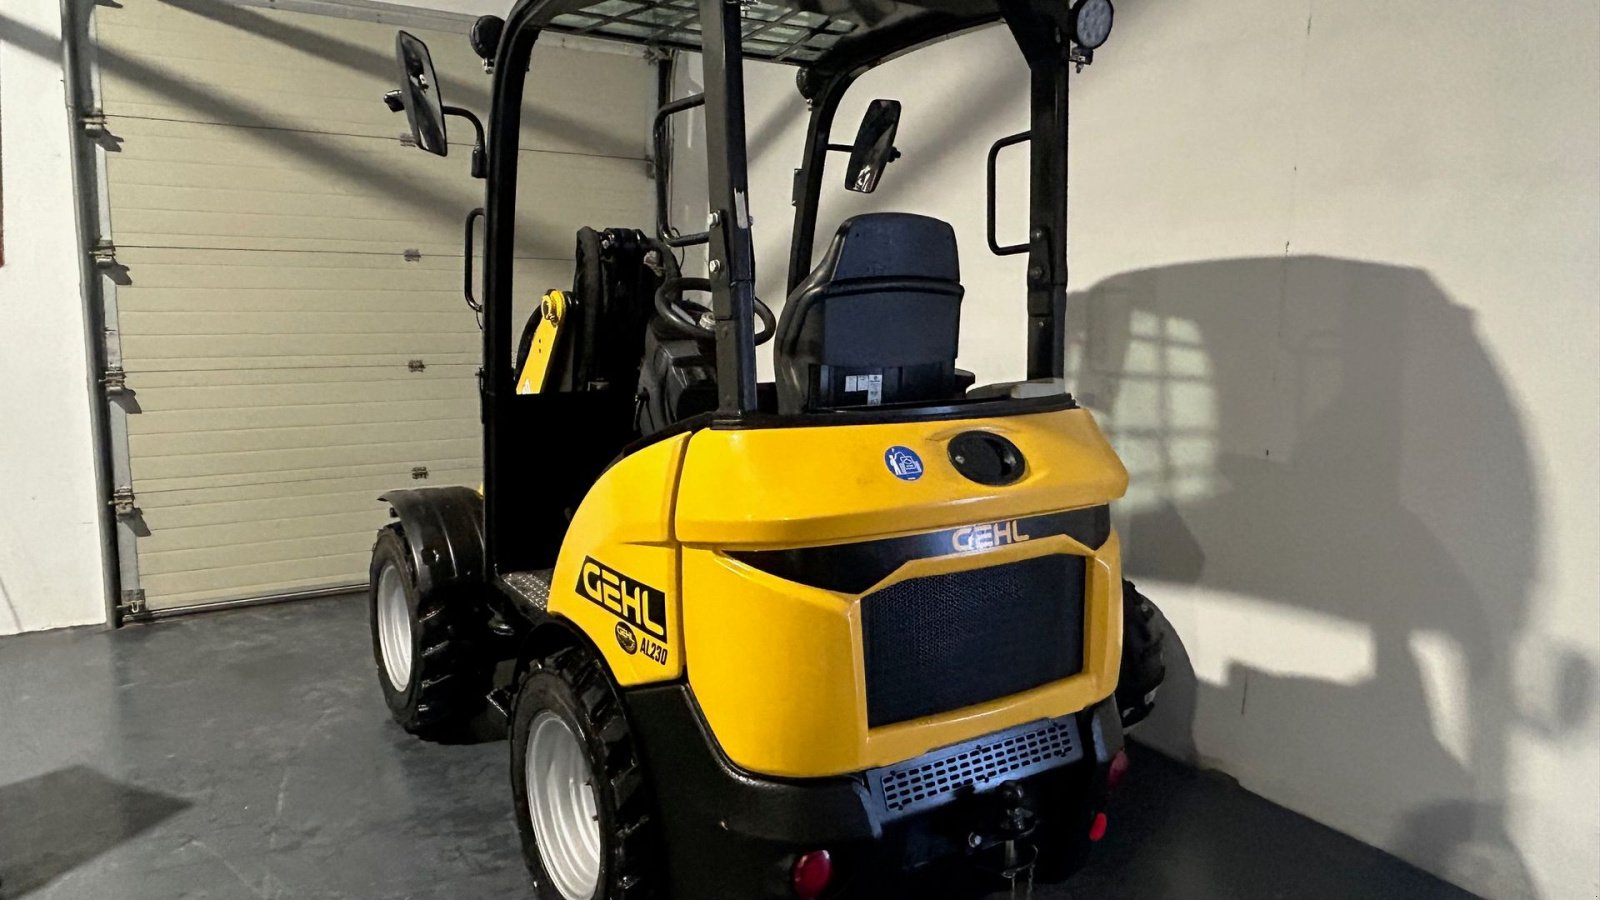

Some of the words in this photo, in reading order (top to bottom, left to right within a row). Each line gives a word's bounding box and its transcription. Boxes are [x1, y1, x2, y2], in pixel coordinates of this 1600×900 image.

[953, 519, 1030, 552] GEHL
[583, 561, 664, 636] GEHL
[640, 637, 668, 666] AL230
